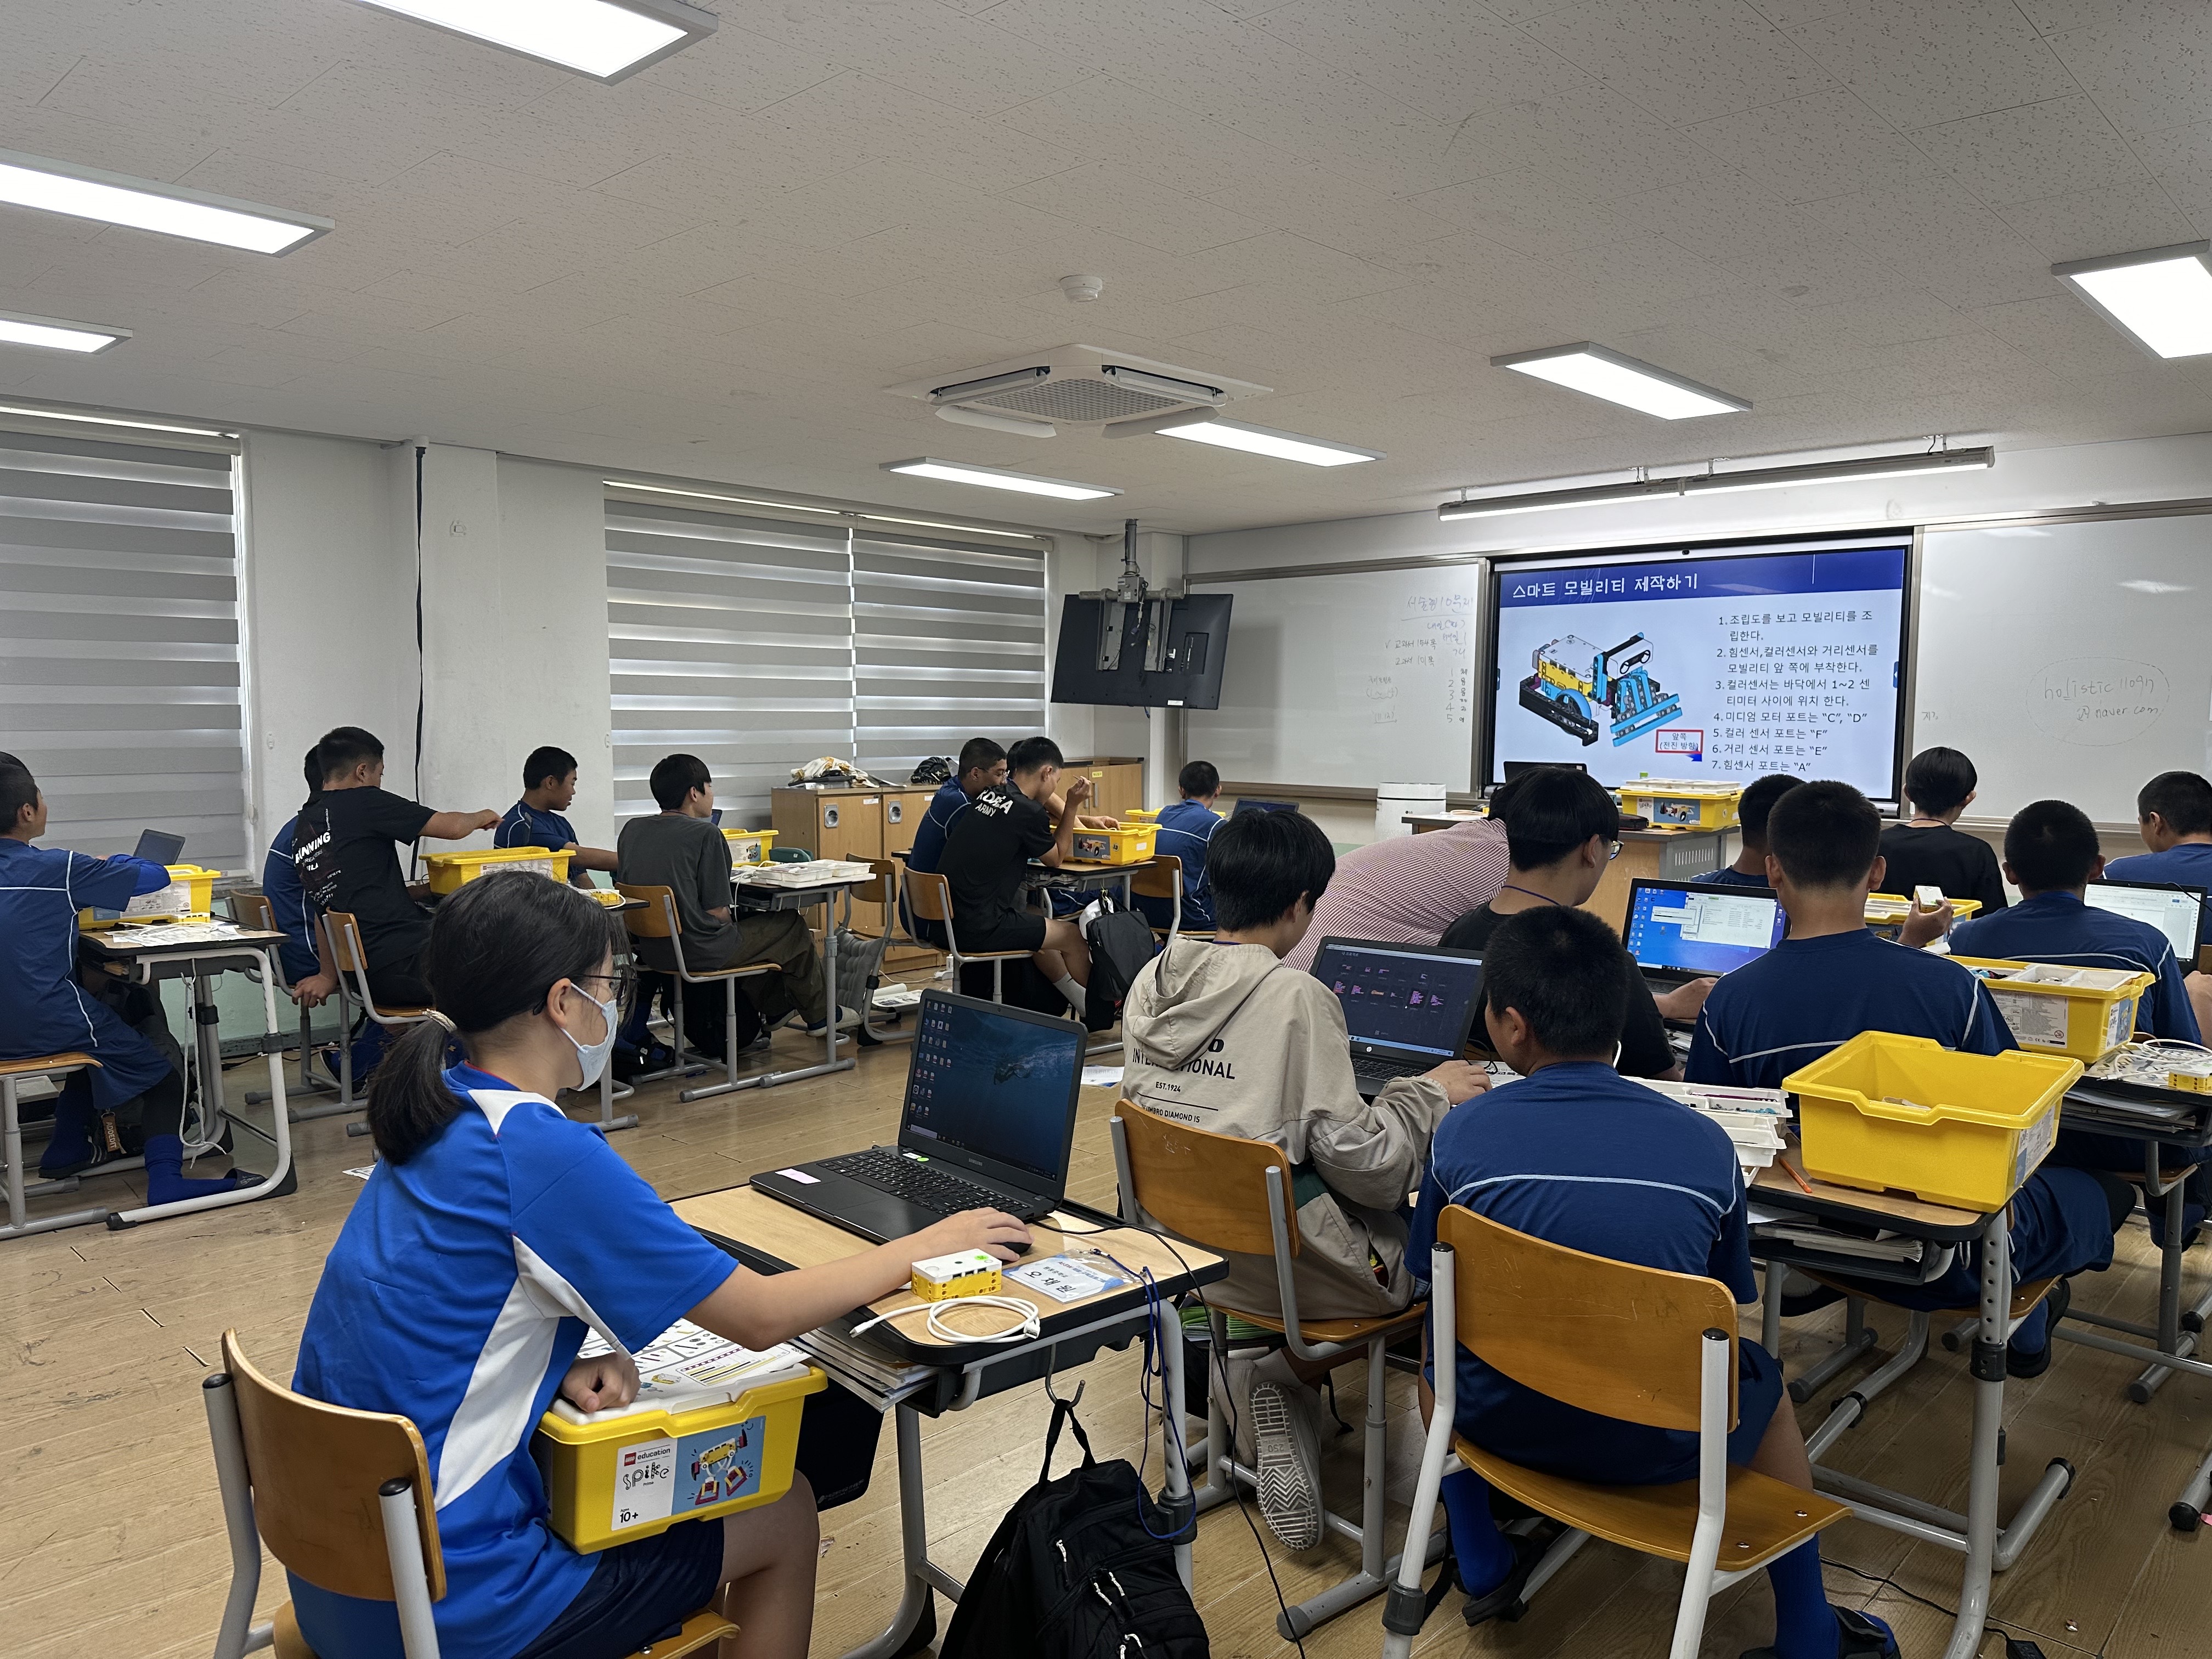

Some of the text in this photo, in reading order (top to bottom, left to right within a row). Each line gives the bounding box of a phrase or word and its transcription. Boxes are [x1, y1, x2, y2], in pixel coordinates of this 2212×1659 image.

[1513, 573, 1697, 598] 스마트 모빌리티 제작하기
[1729, 613, 1771, 625] 조립도를
[1775, 613, 1797, 623] 보고
[1801, 611, 1857, 623] 모빌리티를
[1861, 611, 1873, 620] 조
[1730, 630, 1764, 642] 립한다.
[1822, 644, 1878, 656] 거리센서를
[1728, 662, 1863, 674] 모빌리티 앞 쪽에 부착한다.
[1727, 679, 1779, 690] 컬러센서는
[1784, 679, 1826, 690] 바닥에서
[1832, 680, 1854, 689] 1~2
[1859, 678, 1870, 690] 센
[1726, 695, 1849, 707] 티미터 사이에 위치 한다.
[1726, 712, 1756, 723] 미디엄
[1760, 712, 1781, 723] 모터
[1786, 712, 1819, 723] 포트는
[1725, 727, 1745, 738] 컬러
[1750, 727, 1770, 738] 센서
[1774, 729, 1807, 740] 포트는
[1660, 742, 1677, 750] (전진
[1724, 743, 1744, 755] 거리
[1748, 743, 1769, 755] 센서
[1773, 744, 1806, 756] 포트는
[1723, 759, 1754, 771] 힘센서
[1758, 760, 1790, 772] 포트는
[975, 803, 996, 817] ARMY
[1132, 1047, 1235, 1080] INTIONAL
[1155, 1081, 1181, 1092] EST.1924
[1164, 1110, 1193, 1121] DIAMOND
[637, 1448, 670, 1460] education
[620, 1511, 639, 1523] 10+
